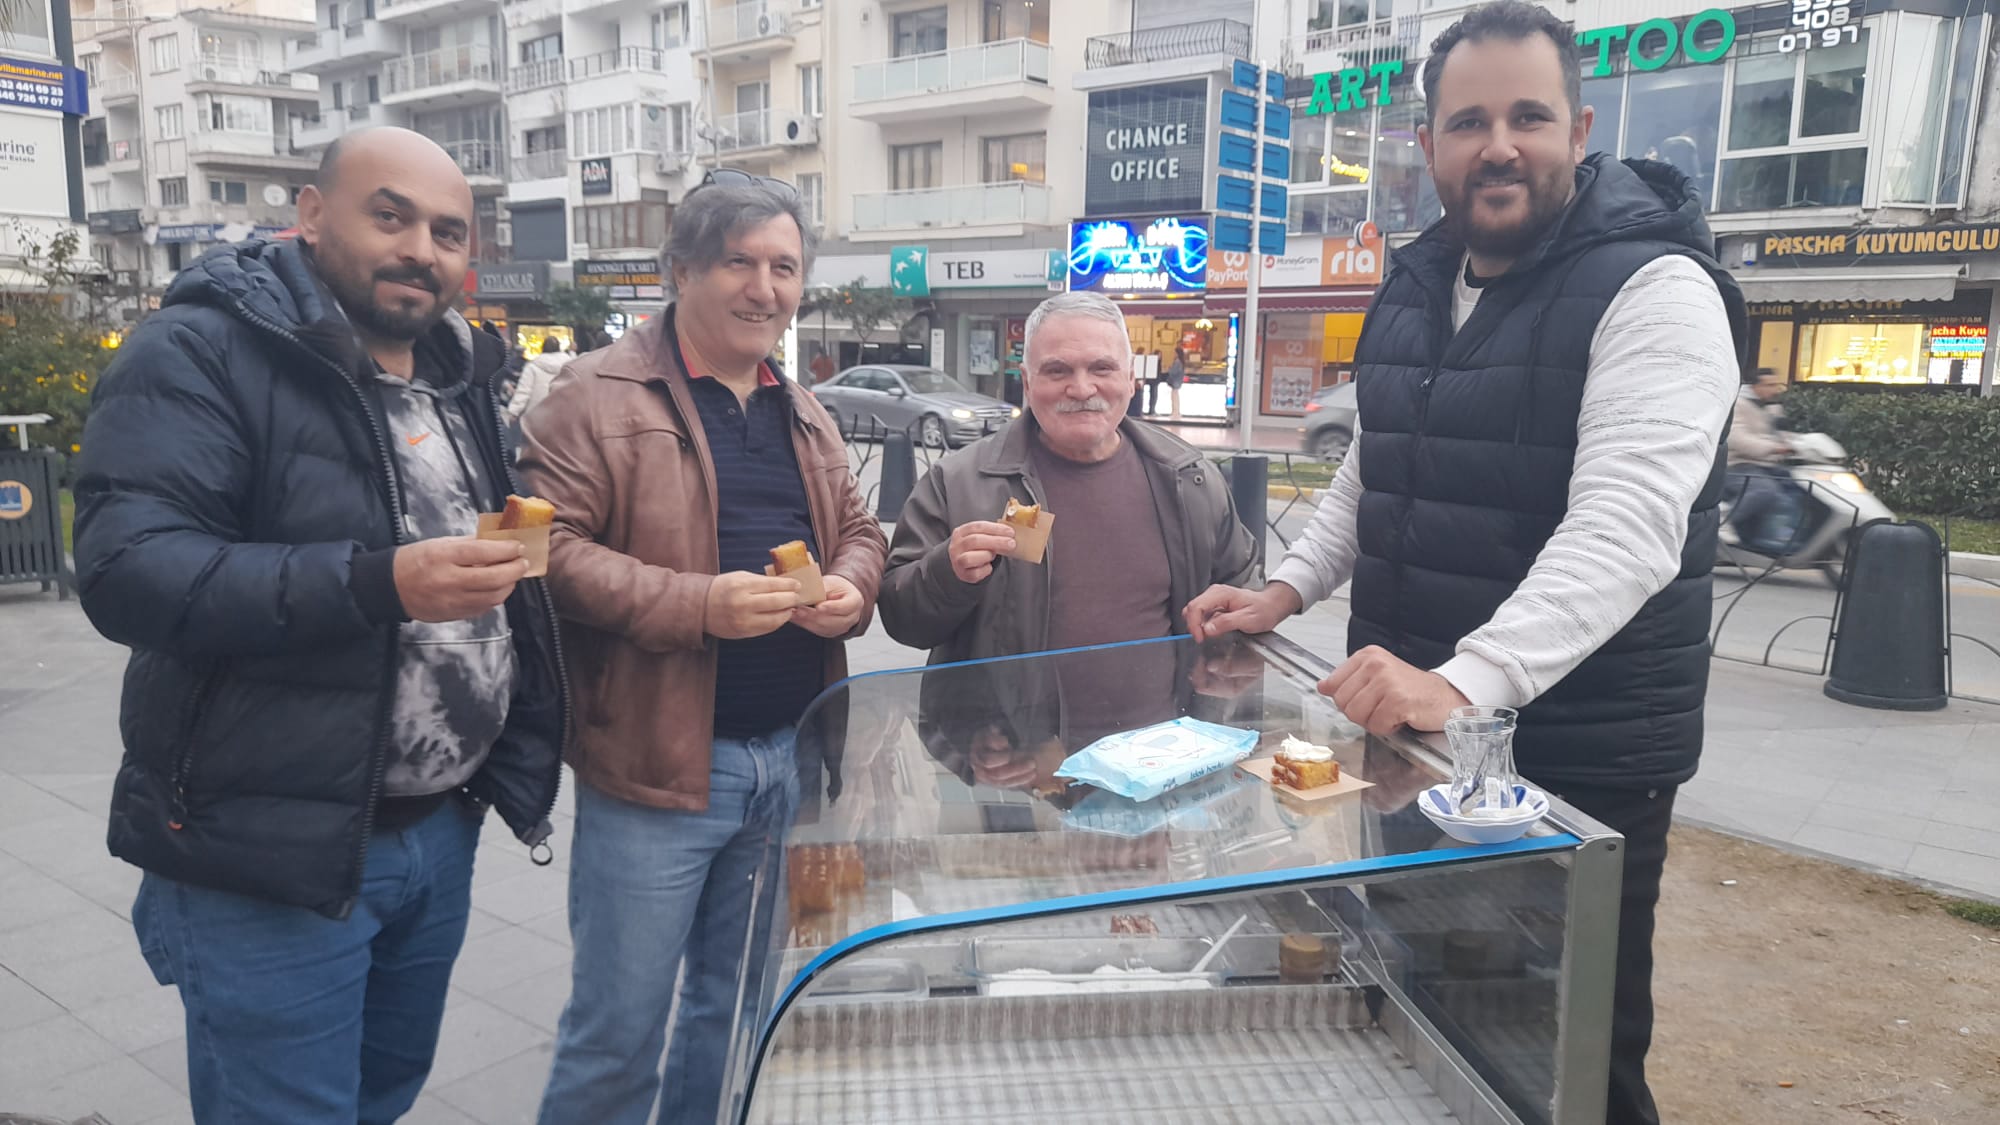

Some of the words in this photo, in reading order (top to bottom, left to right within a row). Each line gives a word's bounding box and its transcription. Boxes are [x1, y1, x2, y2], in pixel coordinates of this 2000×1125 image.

[1791, 6, 1851, 30] 408
[1778, 31, 1812, 53] 07
[1821, 25, 1858, 48] 97
[1304, 60, 1403, 115] ART
[1106, 123, 1188, 151] CHANGE
[1110, 158, 1179, 182] OFFICE
[1331, 239, 1376, 275] ria
[1764, 234, 1847, 256] PASCHA
[943, 261, 985, 280] TEB
[1207, 267, 1249, 286] PayPort
